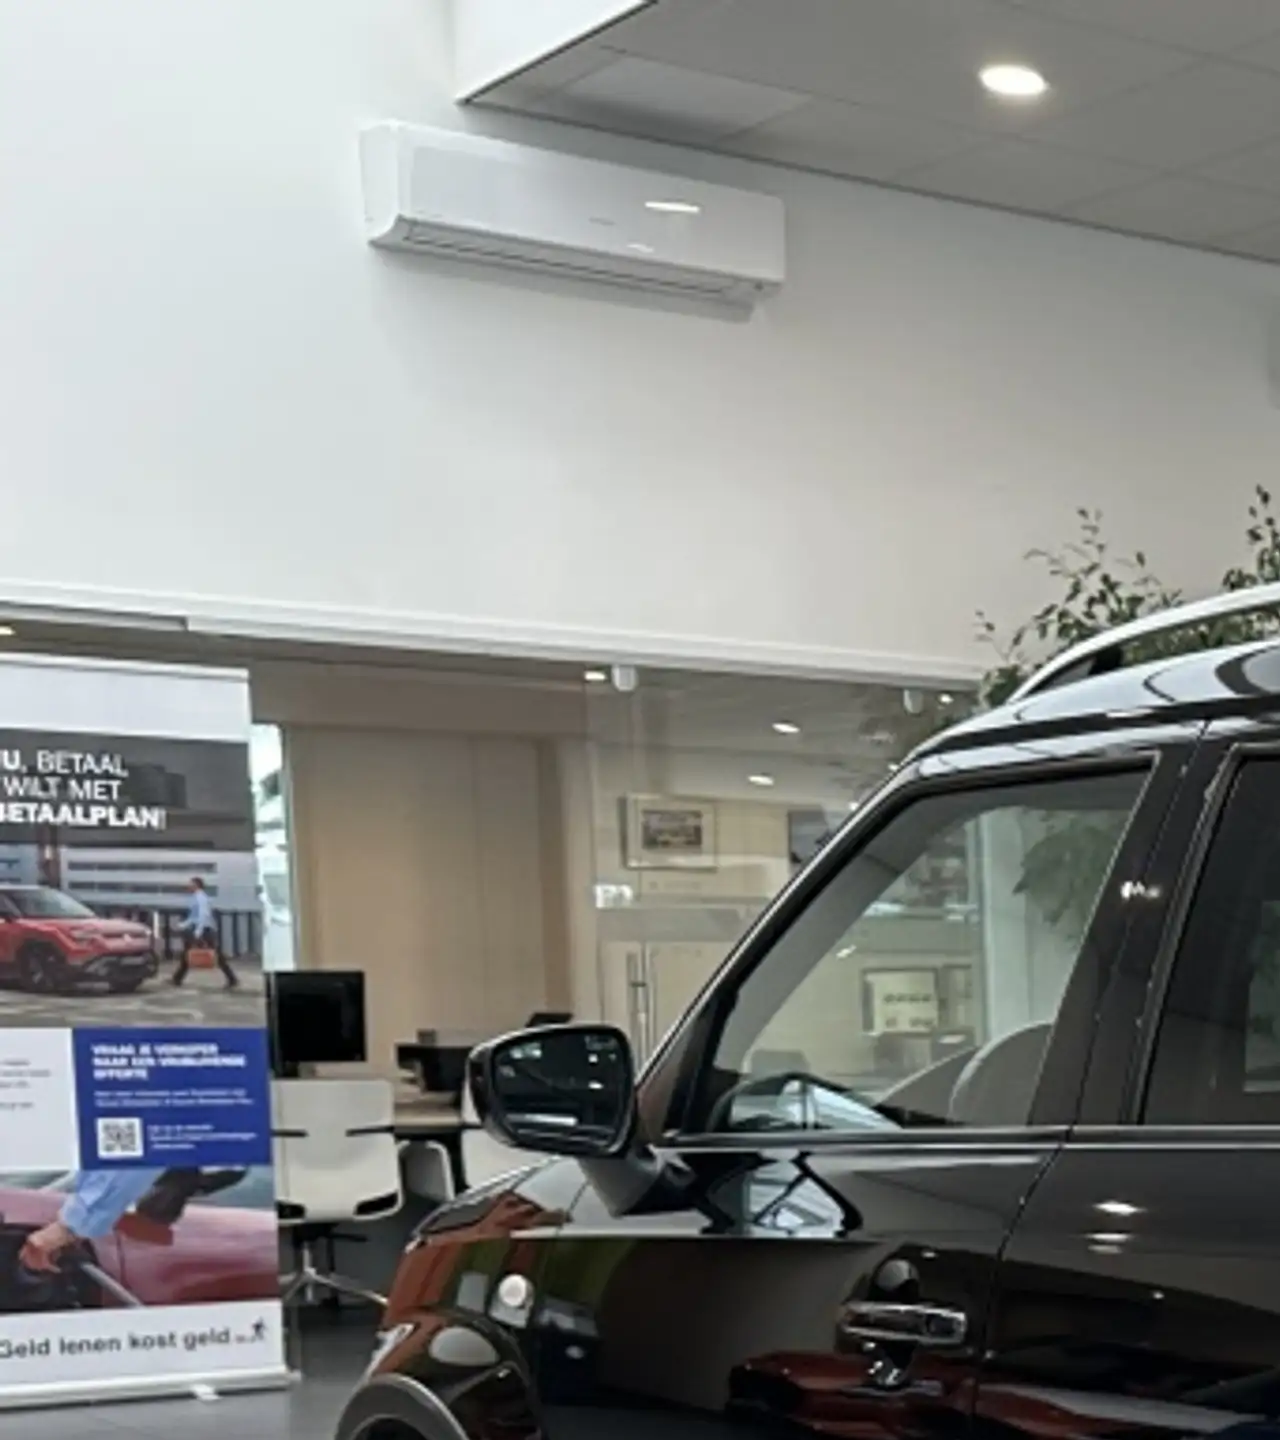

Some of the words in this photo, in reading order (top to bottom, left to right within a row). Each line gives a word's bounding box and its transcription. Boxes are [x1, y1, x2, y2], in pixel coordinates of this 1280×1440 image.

[37, 750, 129, 777] BETAAL
[3, 776, 61, 799] WILT
[68, 778, 122, 800] MET
[59, 1336, 122, 1355] lenen
[128, 1332, 177, 1350] kost
[183, 1327, 231, 1351] geld
